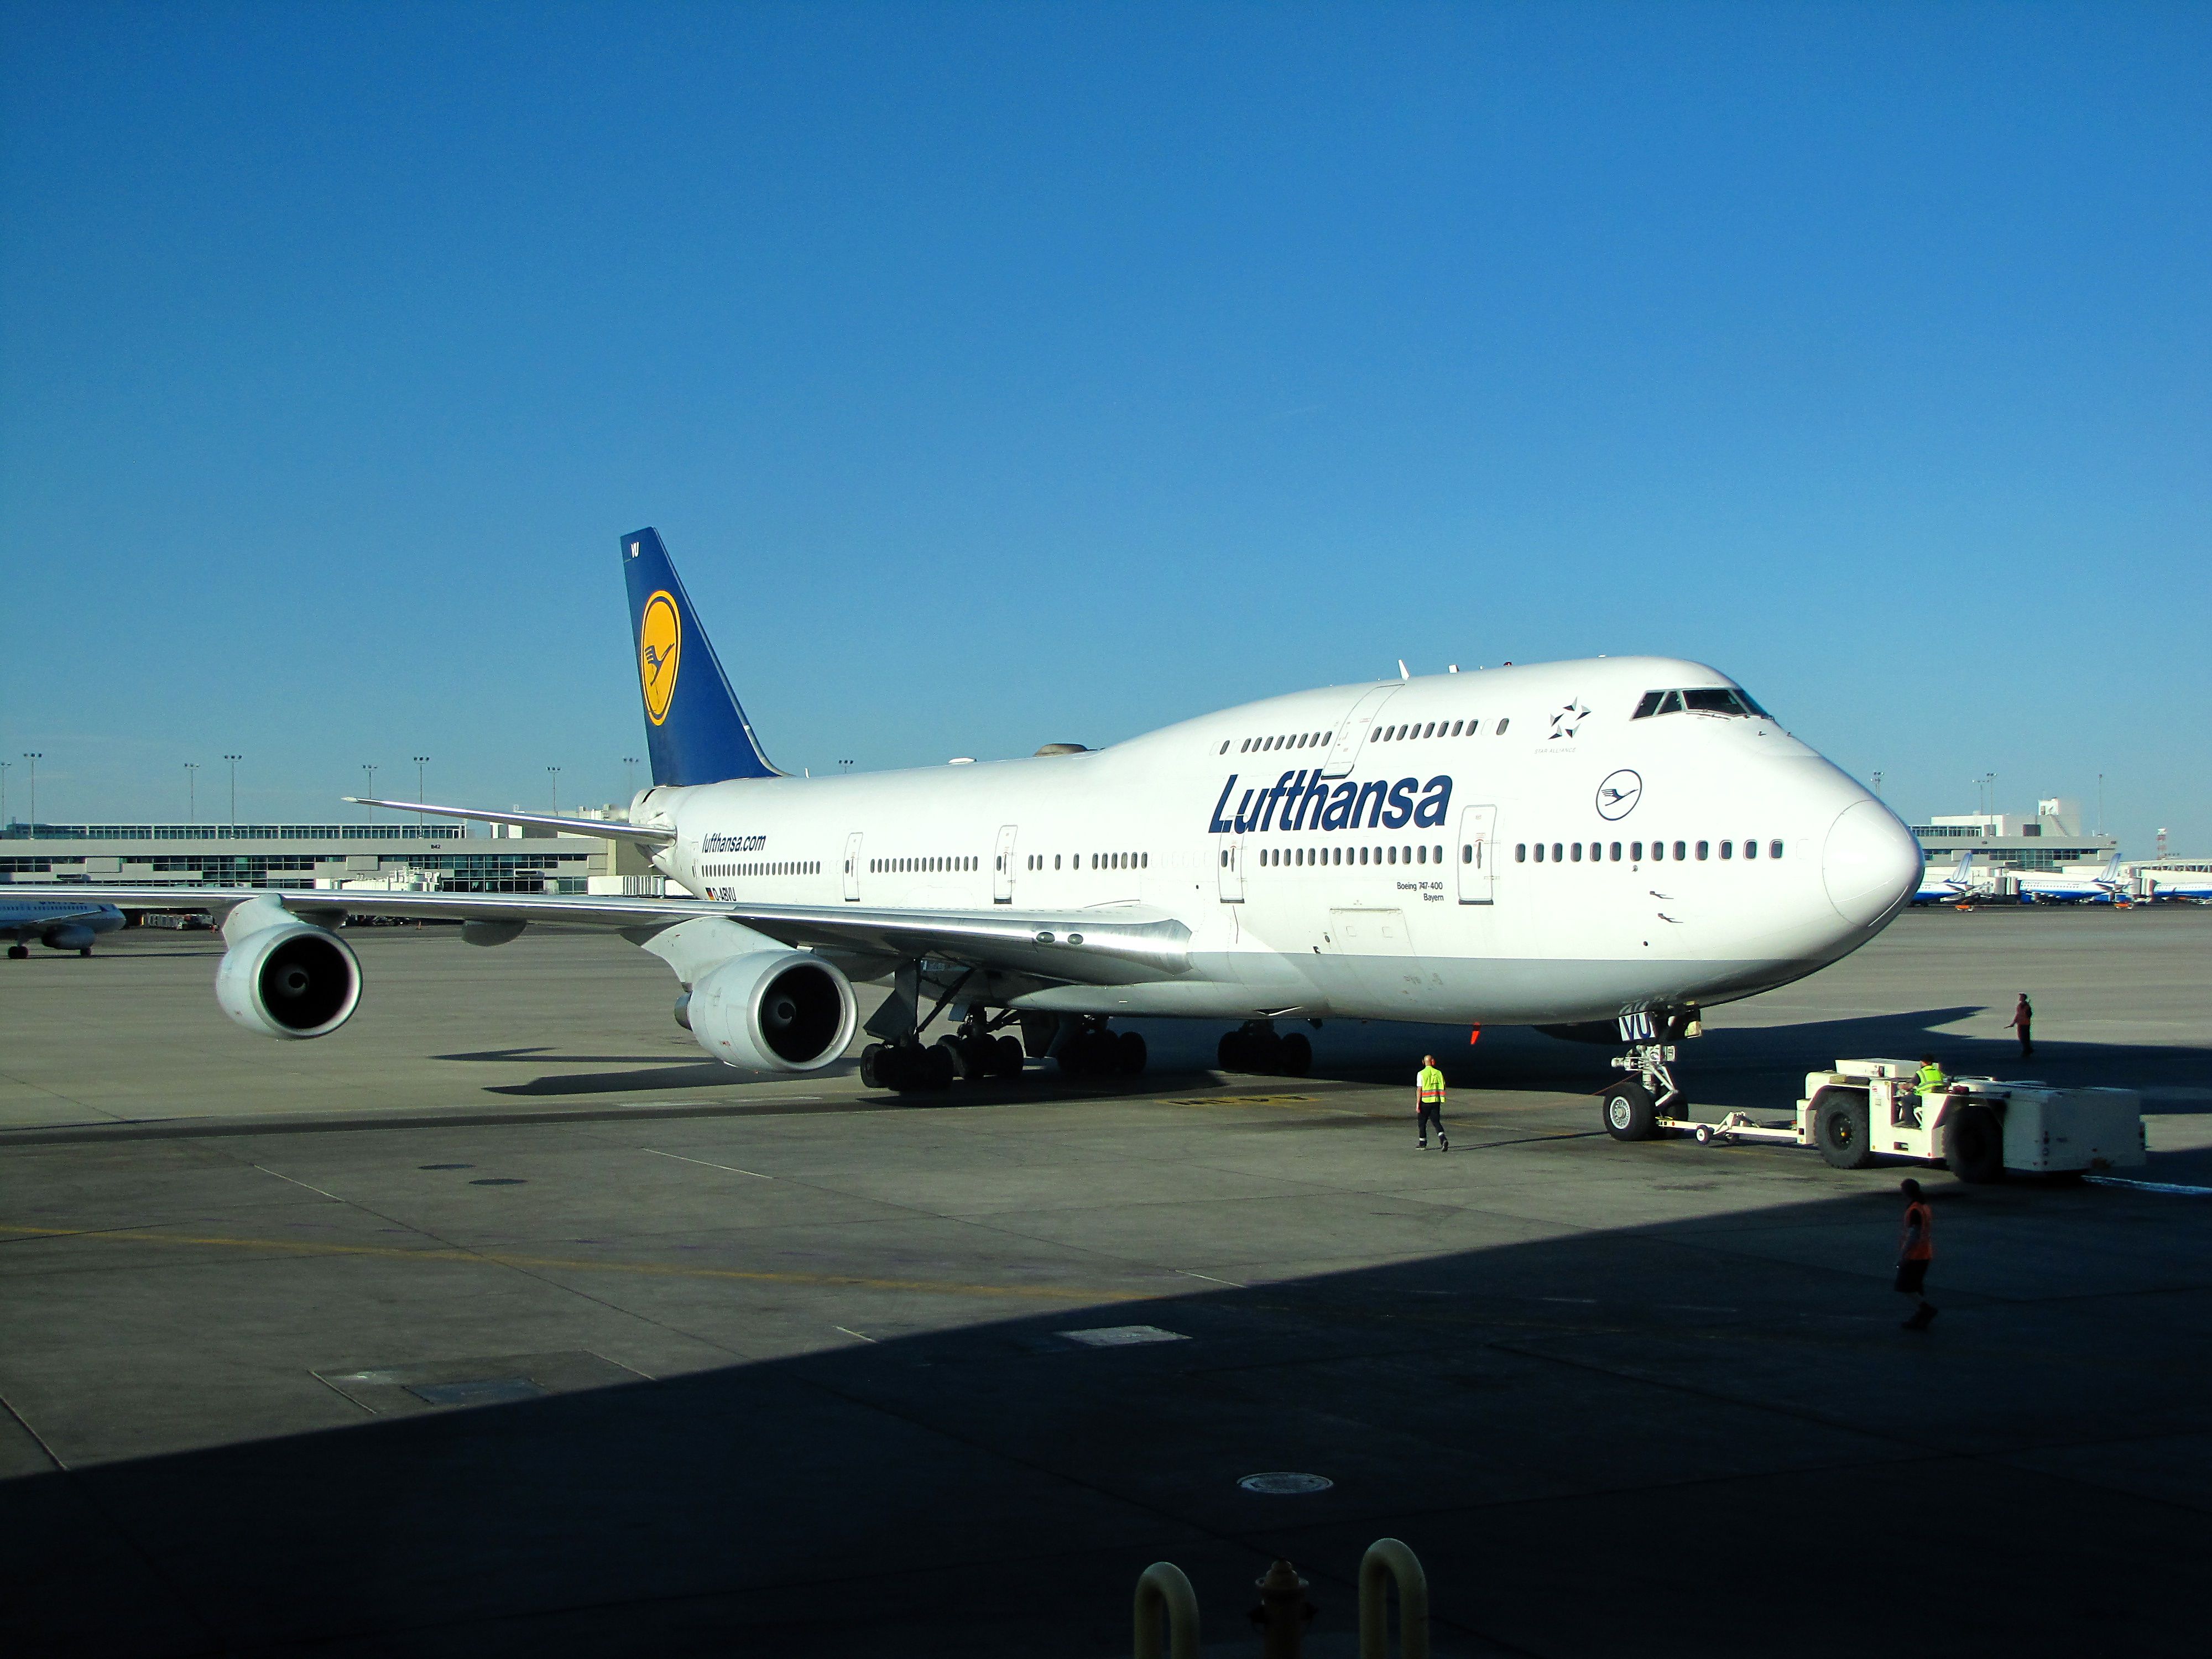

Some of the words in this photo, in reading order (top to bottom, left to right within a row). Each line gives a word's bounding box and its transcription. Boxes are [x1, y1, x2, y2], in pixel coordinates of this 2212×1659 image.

[630, 541, 639, 558] VU
[1208, 768, 1453, 834] Lufthansa
[701, 832, 766, 853] lufthansa.com
[712, 887, 737, 901] D-ABVU
[1396, 881, 1417, 891] Boeing
[1418, 881, 1443, 890] 747-400
[1423, 893, 1444, 902] Bayern
[1621, 1013, 1652, 1041] VU
